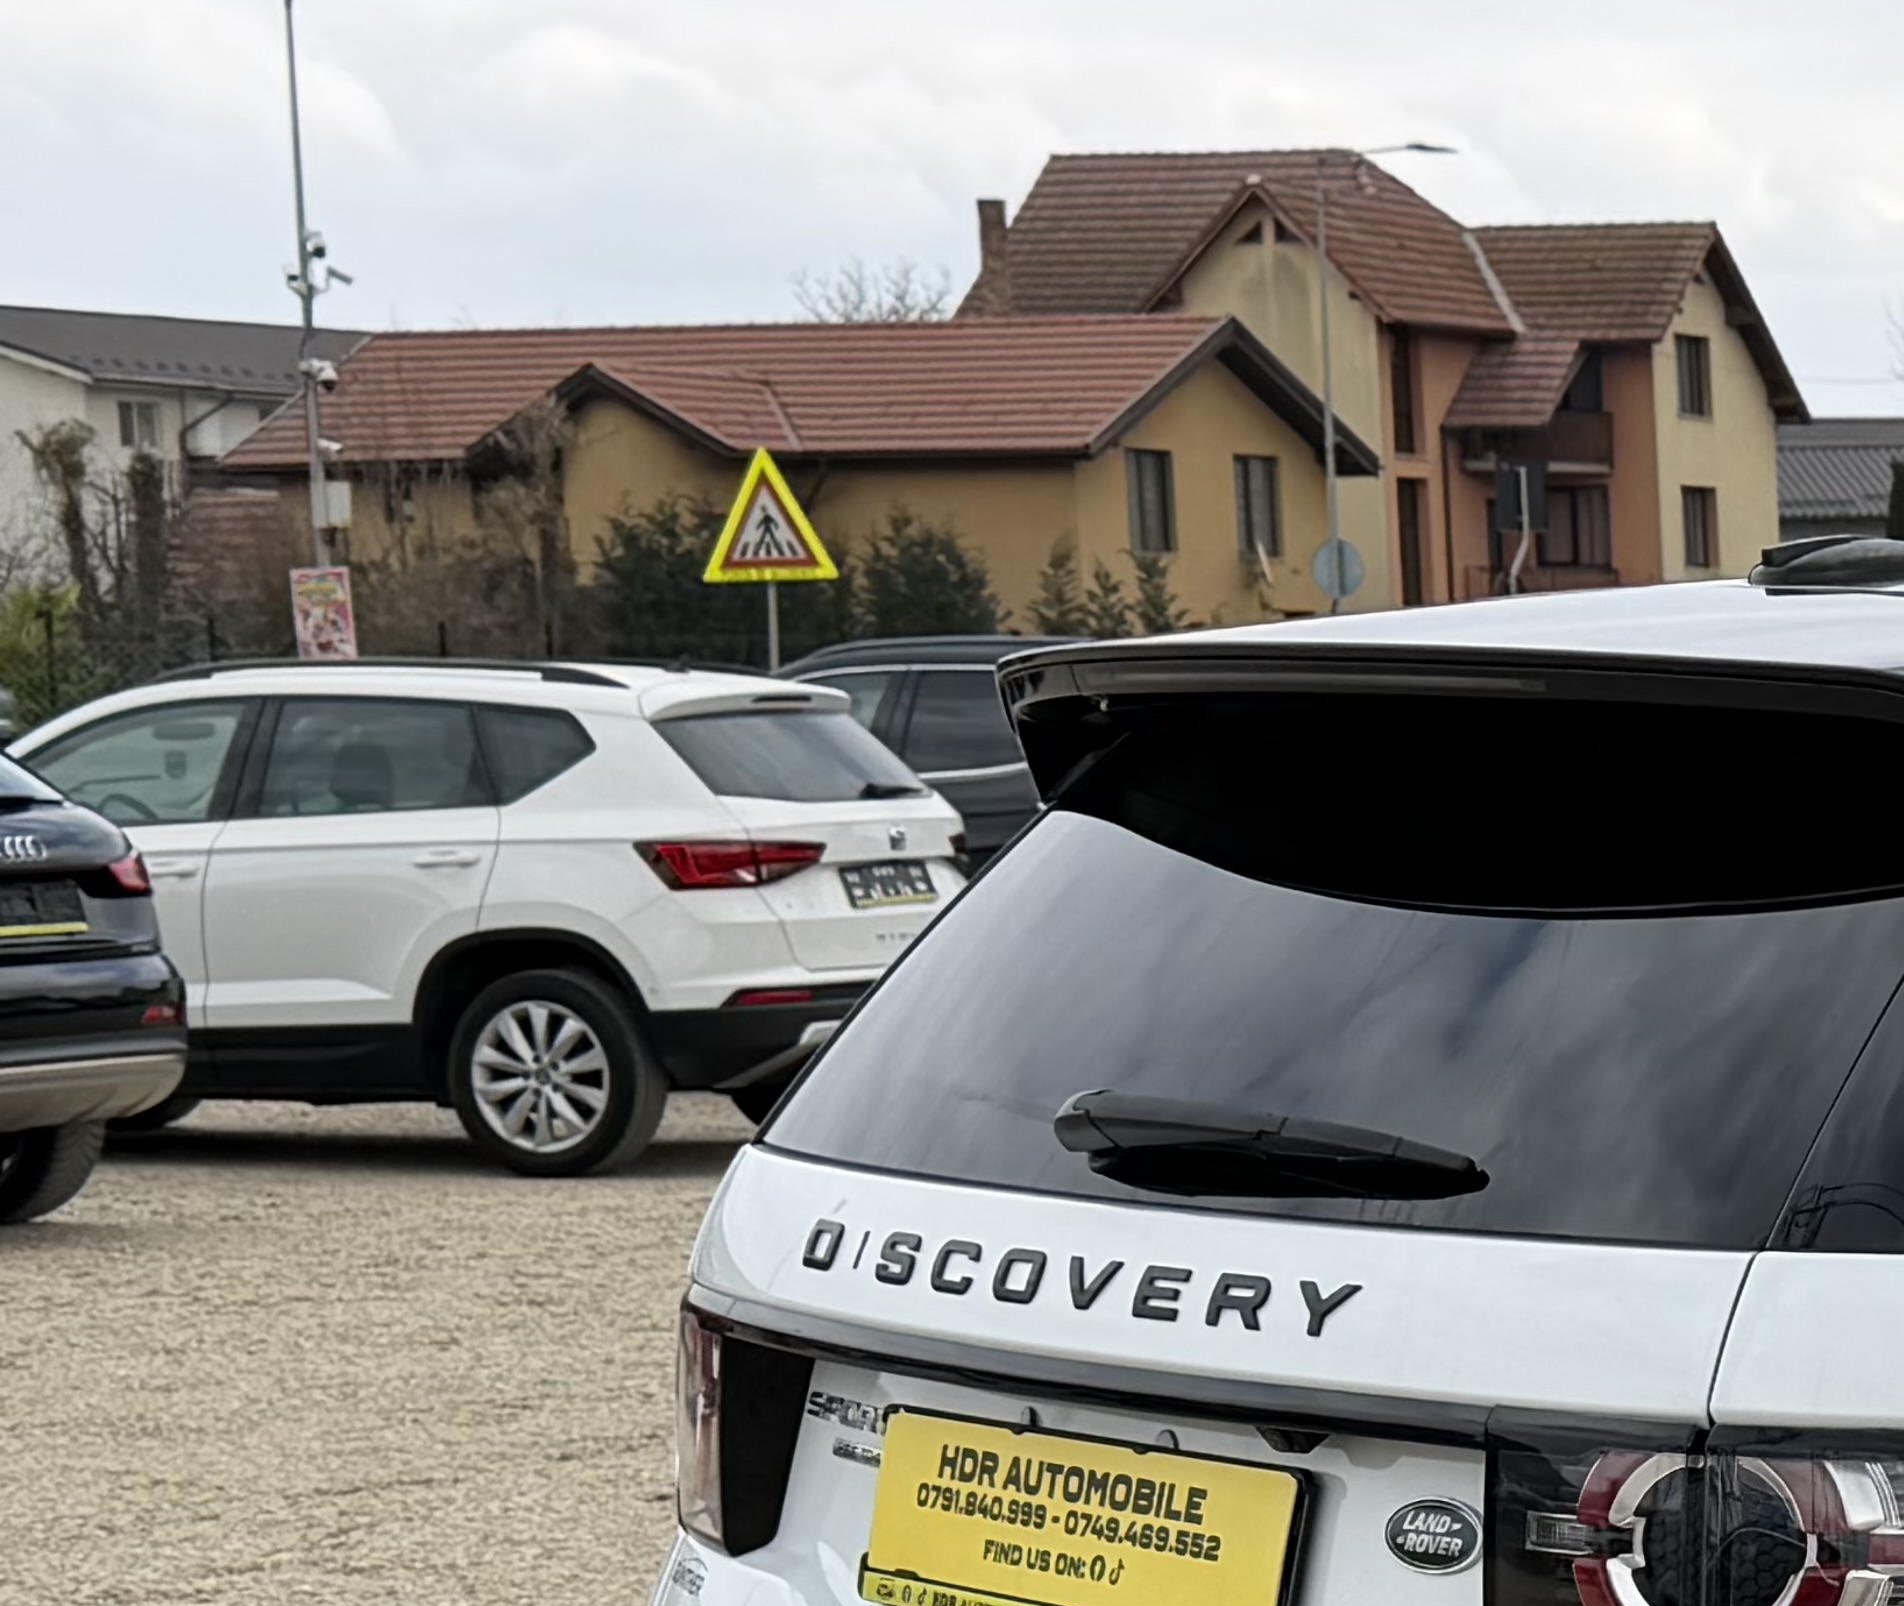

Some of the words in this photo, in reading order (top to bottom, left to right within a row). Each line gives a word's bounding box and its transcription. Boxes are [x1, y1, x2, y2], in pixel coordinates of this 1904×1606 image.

[802, 1218, 1363, 1337] DISCOVERY
[937, 1444, 999, 1488] HDR
[1002, 1456, 1208, 1526] AUTOMOBILE
[984, 1539, 1023, 1567] FIND
[1027, 1548, 1052, 1572] US
[1055, 1553, 1087, 1579] ON:
[1064, 1510, 1221, 1562] 0749.469.552
